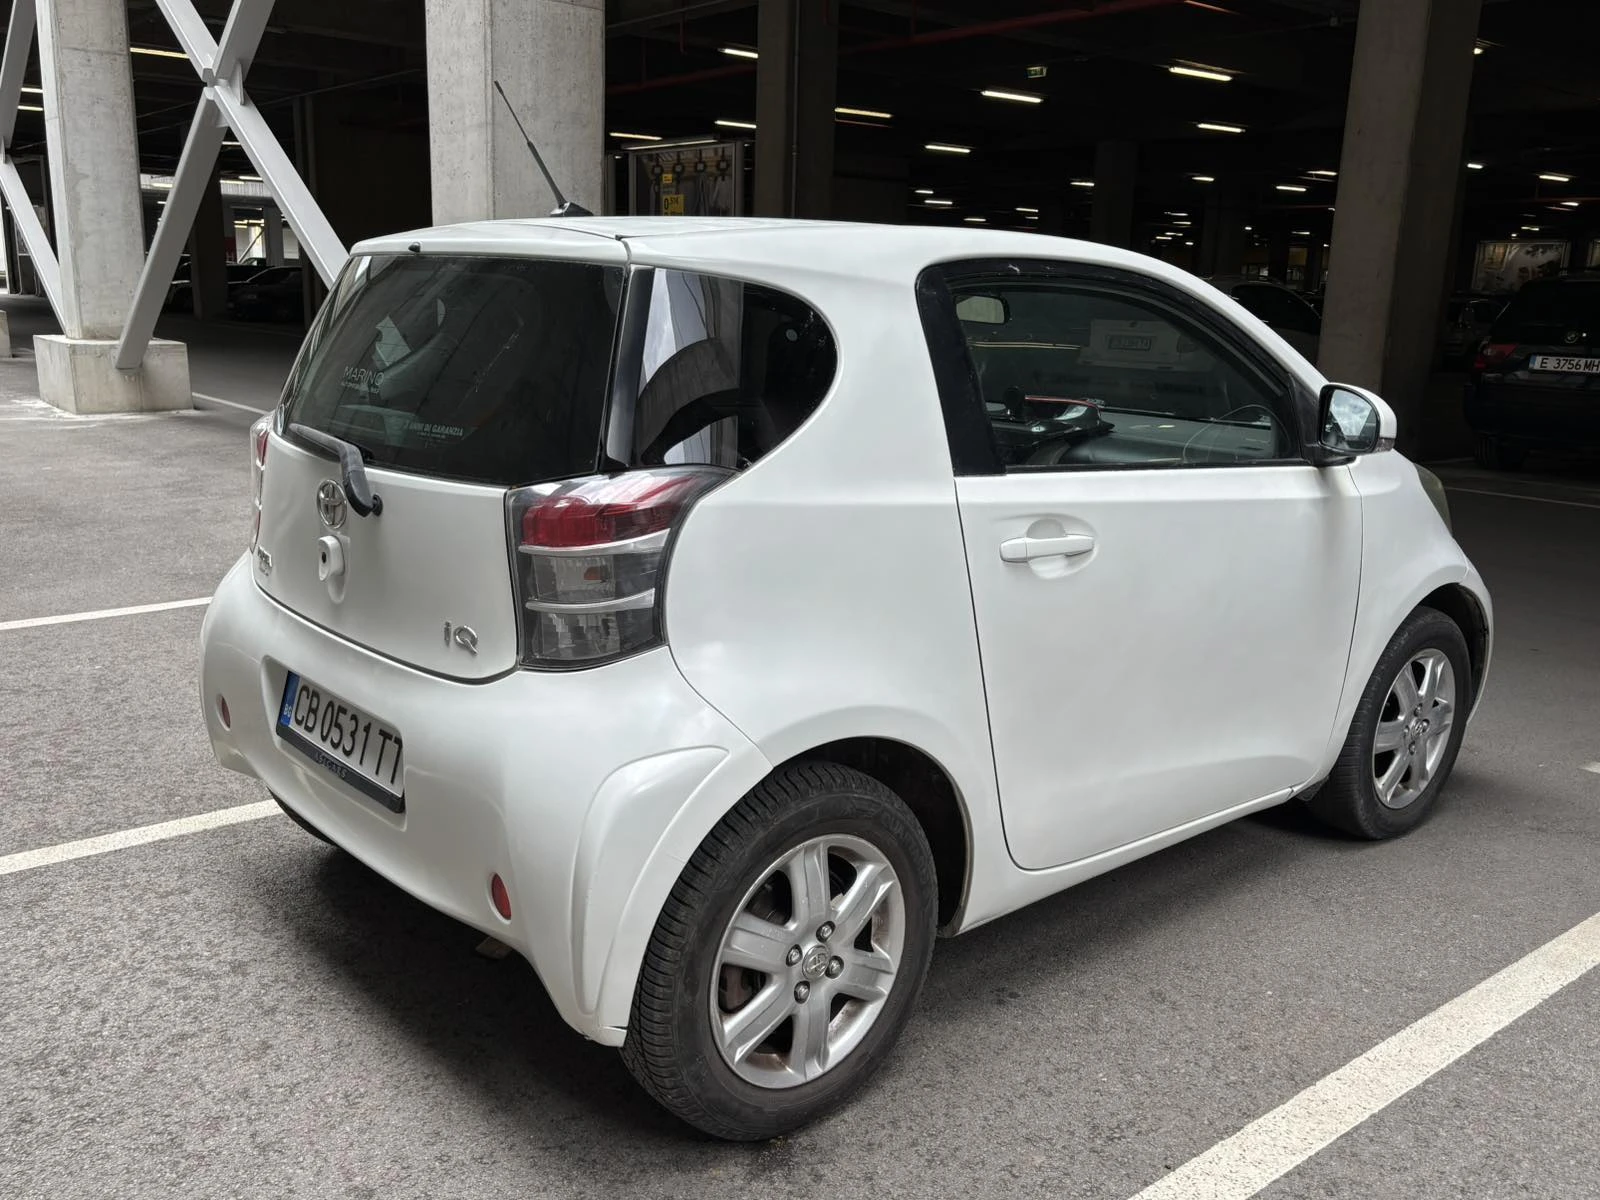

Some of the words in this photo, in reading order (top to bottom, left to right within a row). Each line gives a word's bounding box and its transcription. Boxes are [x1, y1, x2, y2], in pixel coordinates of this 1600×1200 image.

[1540, 357, 1549, 369] E
[1553, 358, 1582, 370] 3756
[1584, 359, 1600, 372] MH
[343, 366, 385, 386] MARINO
[294, 684, 321, 733] CB
[320, 700, 372, 766] 0531
